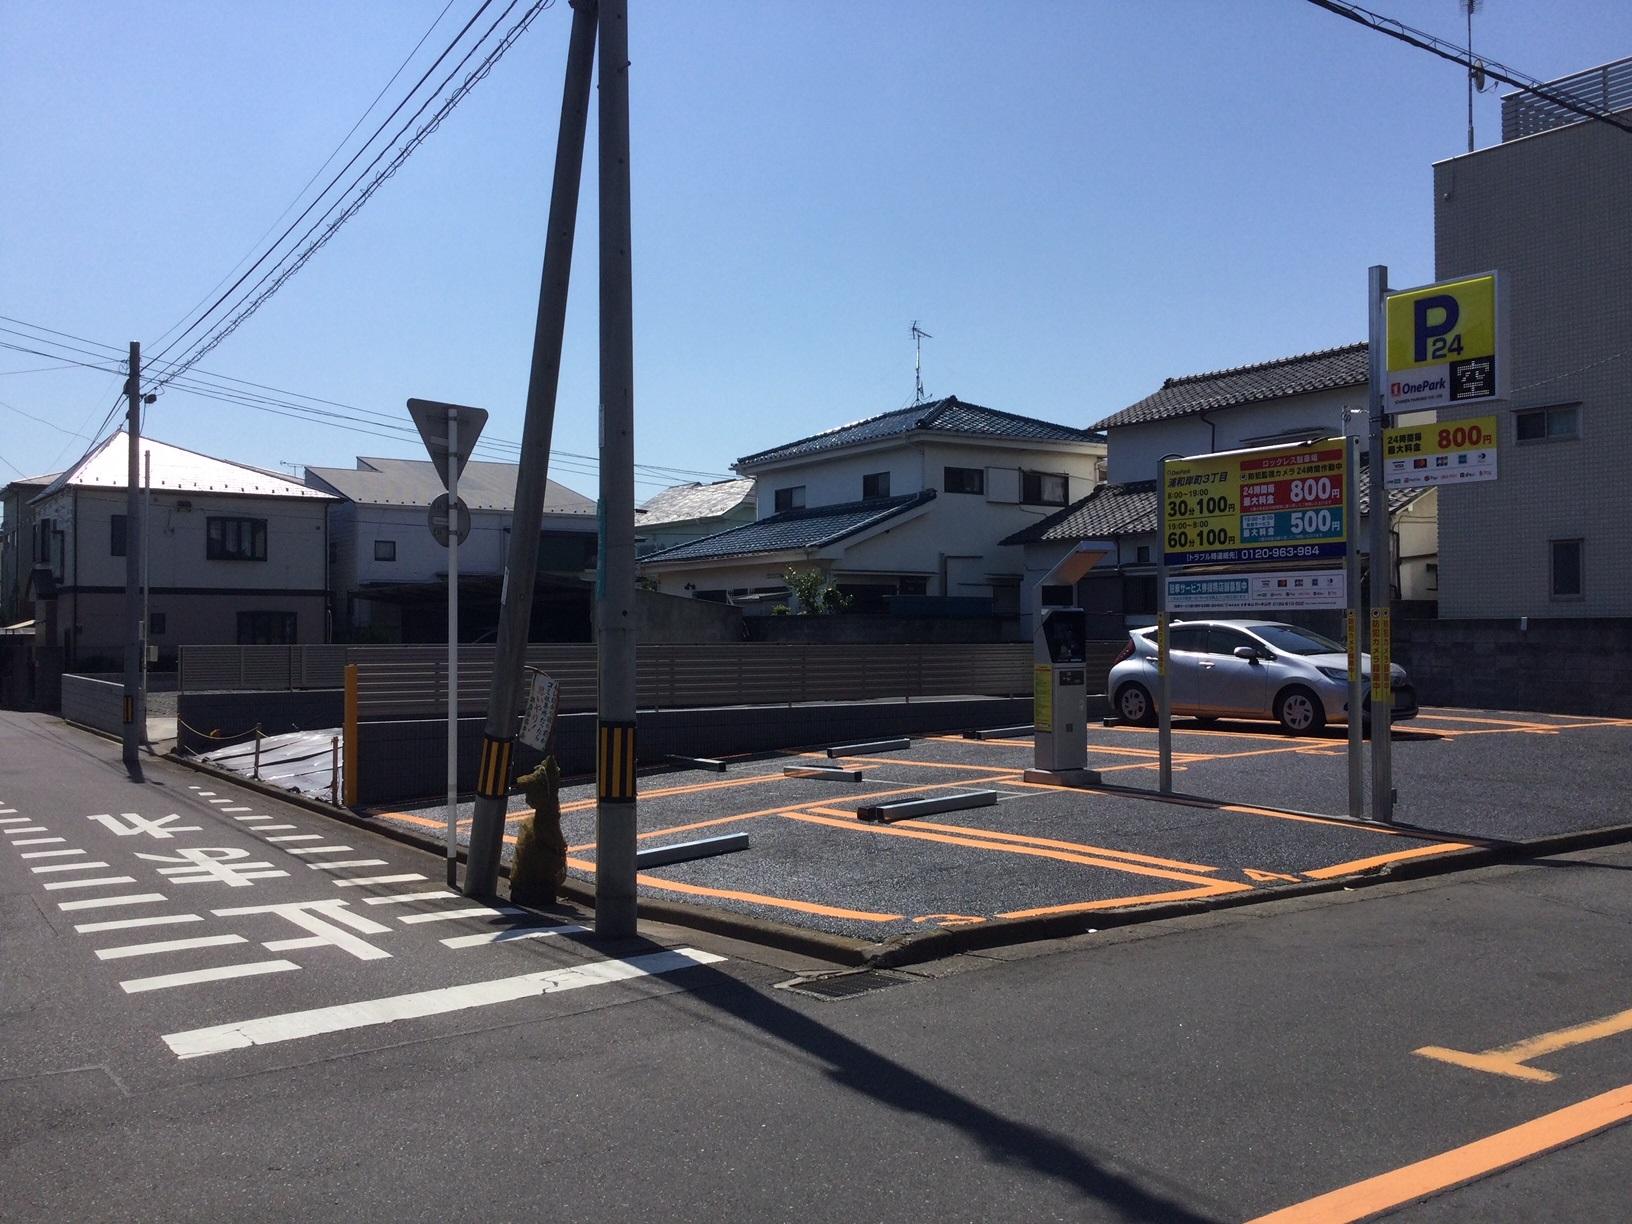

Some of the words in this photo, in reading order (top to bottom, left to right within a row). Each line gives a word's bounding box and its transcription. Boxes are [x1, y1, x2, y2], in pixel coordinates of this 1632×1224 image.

[1414, 294, 1459, 363] P
[1431, 334, 1464, 360] 24
[1402, 377, 1446, 395] OnePark
[1456, 360, 1490, 399] 空
[1387, 444, 1422, 455] 最大料金
[1438, 425, 1492, 450] 800円
[1290, 477, 1340, 503] 800円
[1290, 509, 1340, 534] 500円
[1241, 545, 1320, 560] 0120-963-984
[86, 812, 394, 961] 止まれ
